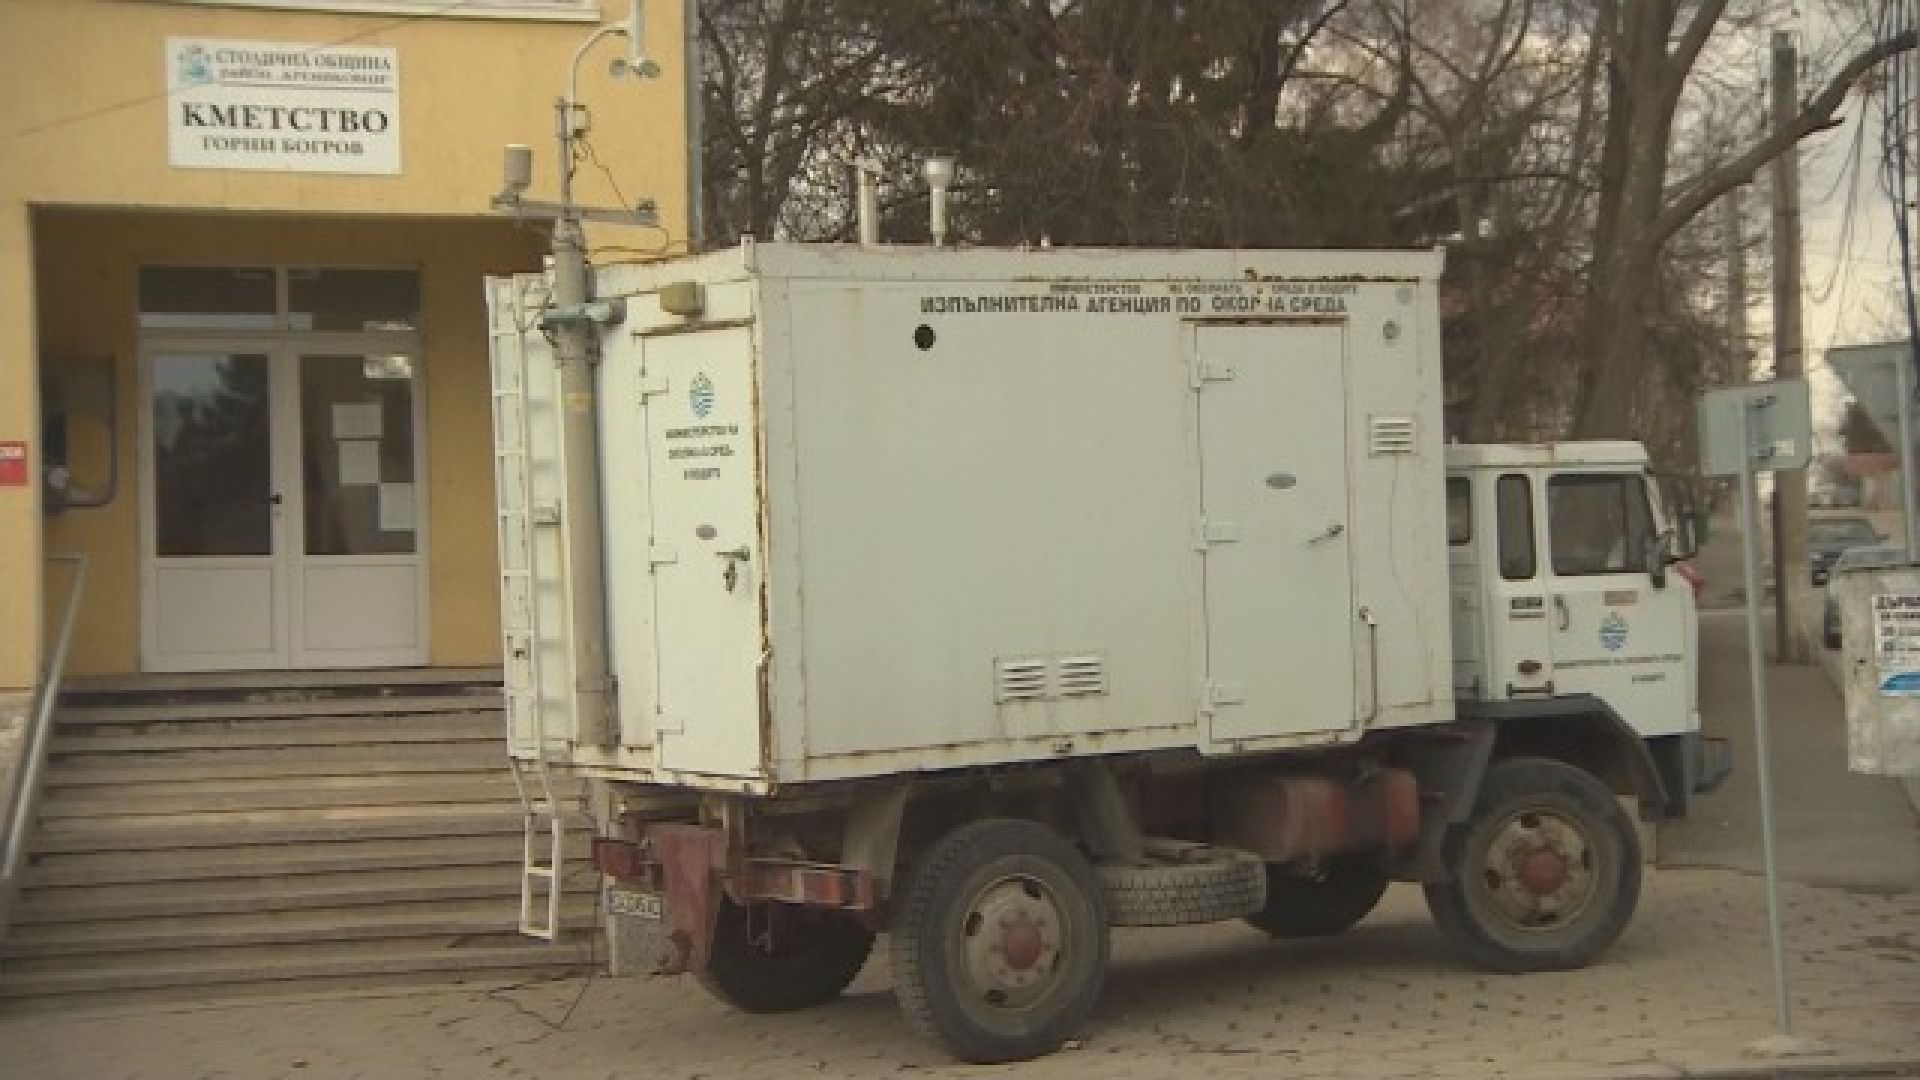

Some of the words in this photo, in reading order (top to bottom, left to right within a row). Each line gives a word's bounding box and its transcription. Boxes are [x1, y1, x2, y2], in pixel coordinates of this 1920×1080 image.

[181, 102, 388, 133] КМЕТСТВО
[202, 136, 274, 152] ГОРНИ
[282, 139, 364, 155] БОГРОВ
[920, 295, 1078, 313] ИЗПЪЛНИТЕЛНА
[1086, 295, 1171, 316] АГЕНЦИЯ
[1175, 296, 1201, 313] ПО
[1288, 295, 1348, 313] СРЕДА
